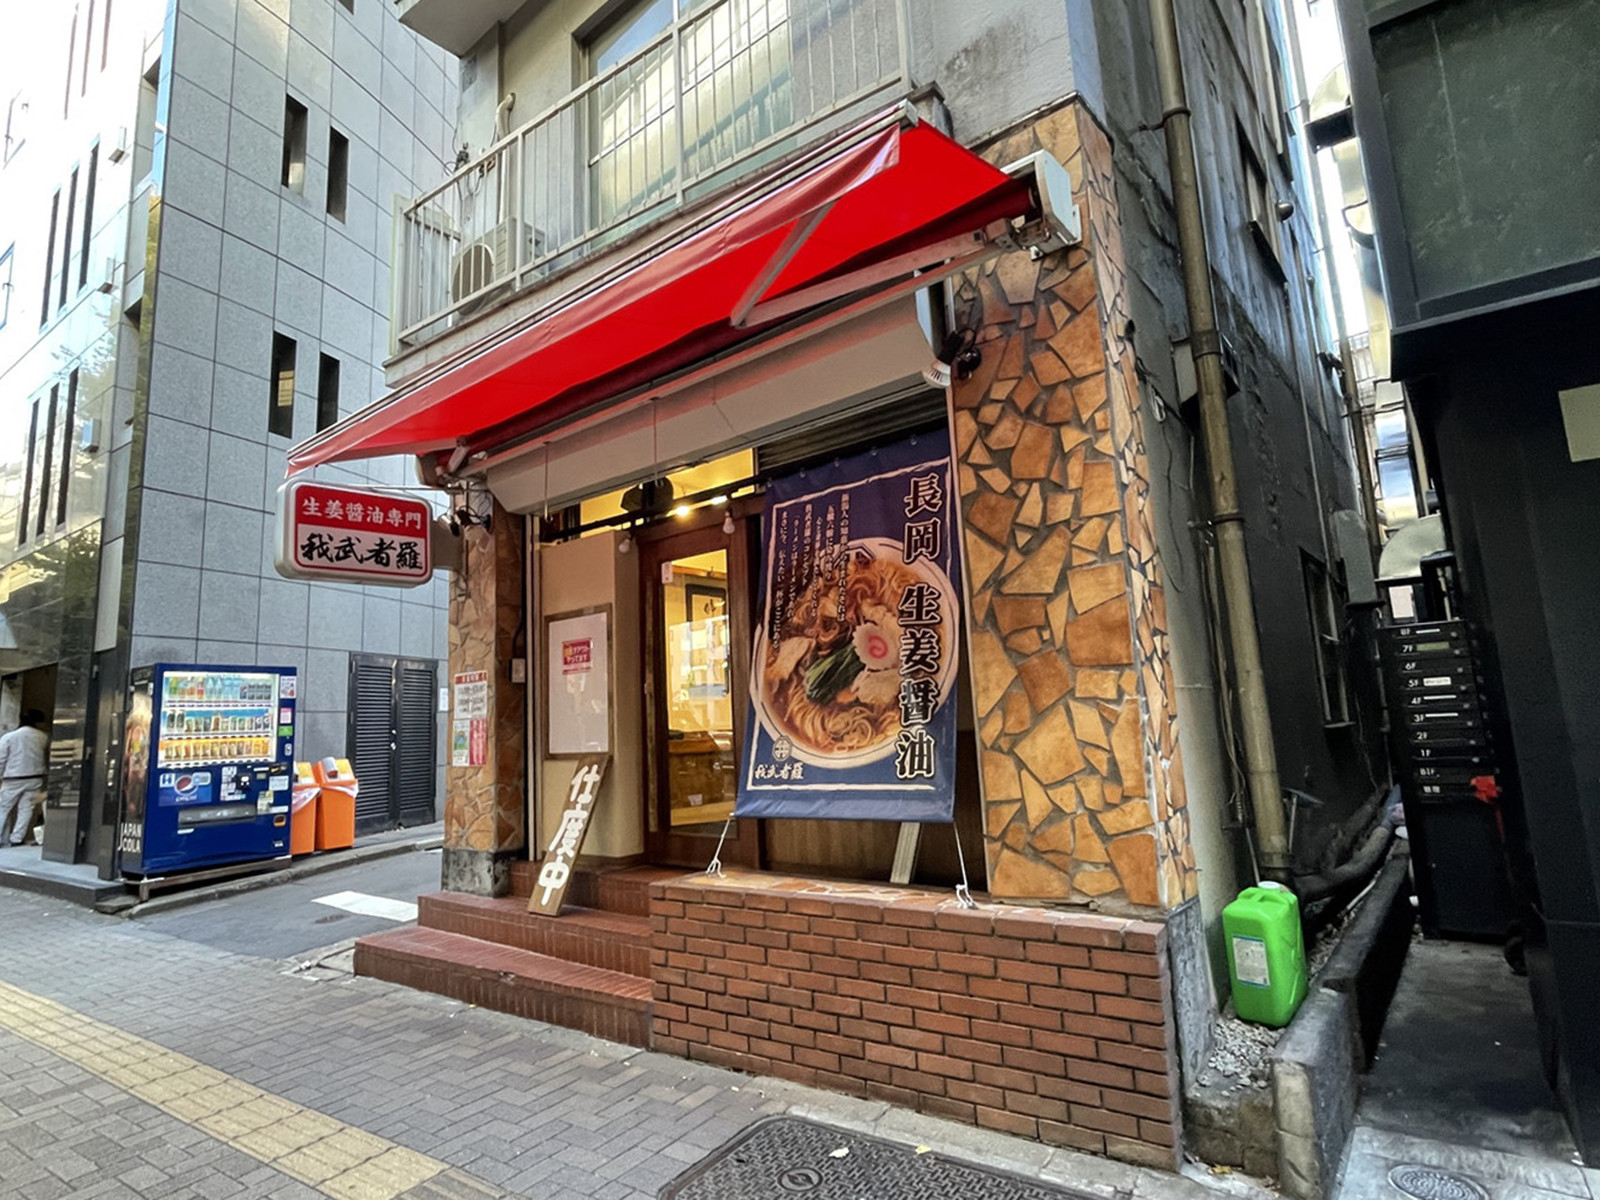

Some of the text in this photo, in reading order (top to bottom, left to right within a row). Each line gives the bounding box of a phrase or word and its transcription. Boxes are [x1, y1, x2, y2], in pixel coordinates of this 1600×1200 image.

[903, 472, 942, 564] 長岡
[300, 532, 423, 570] 我武者羅
[1405, 662, 1416, 670] 6F
[1408, 679, 1418, 687] 5F
[1411, 696, 1422, 704] 4F
[1414, 713, 1425, 722] 3F
[1416, 731, 1428, 740] 2F
[1420, 749, 1431, 757] 1F
[538, 764, 601, 906] 仕度中
